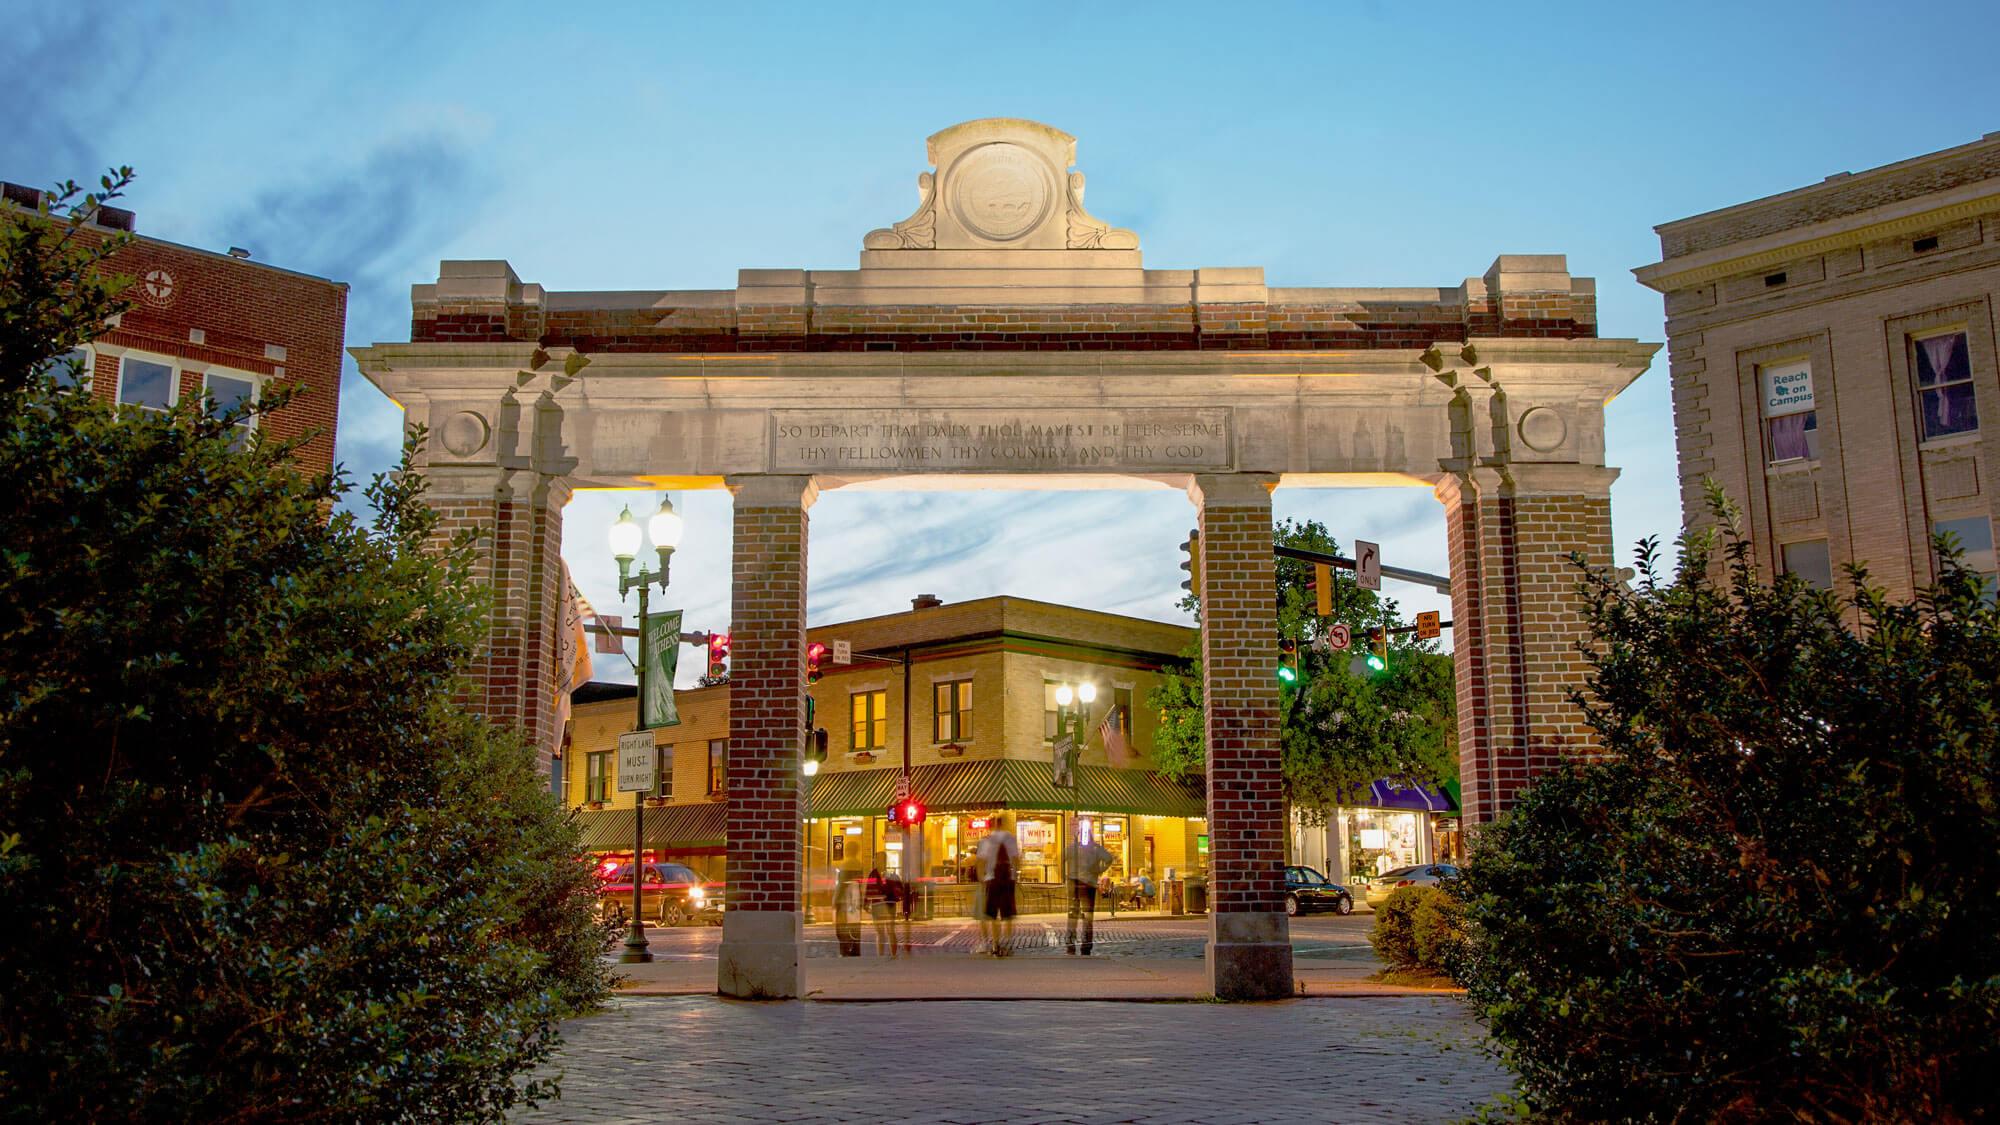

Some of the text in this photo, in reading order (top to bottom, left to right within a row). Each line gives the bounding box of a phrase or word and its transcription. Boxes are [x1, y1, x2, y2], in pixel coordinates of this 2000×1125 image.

[1774, 371, 1808, 385] Reach
[1792, 385, 1806, 394] on
[1769, 393, 1813, 407] Campus
[779, 425, 802, 438] SO
[809, 425, 873, 438] DEPART
[882, 424, 920, 438] THAT
[927, 424, 969, 437] DAILY
[979, 424, 1022, 437] THOU
[1174, 423, 1224, 437] SERVE
[799, 445, 1203, 460] THY FELLOWMEN THY COUNTRY AND THY GOD
[1360, 575, 1377, 586] ONLY
[648, 615, 680, 645] WELCOME
[621, 738, 652, 750] RIGHT LANE
[626, 755, 646, 768] MUST
[620, 772, 652, 784] TURN RIGHT
